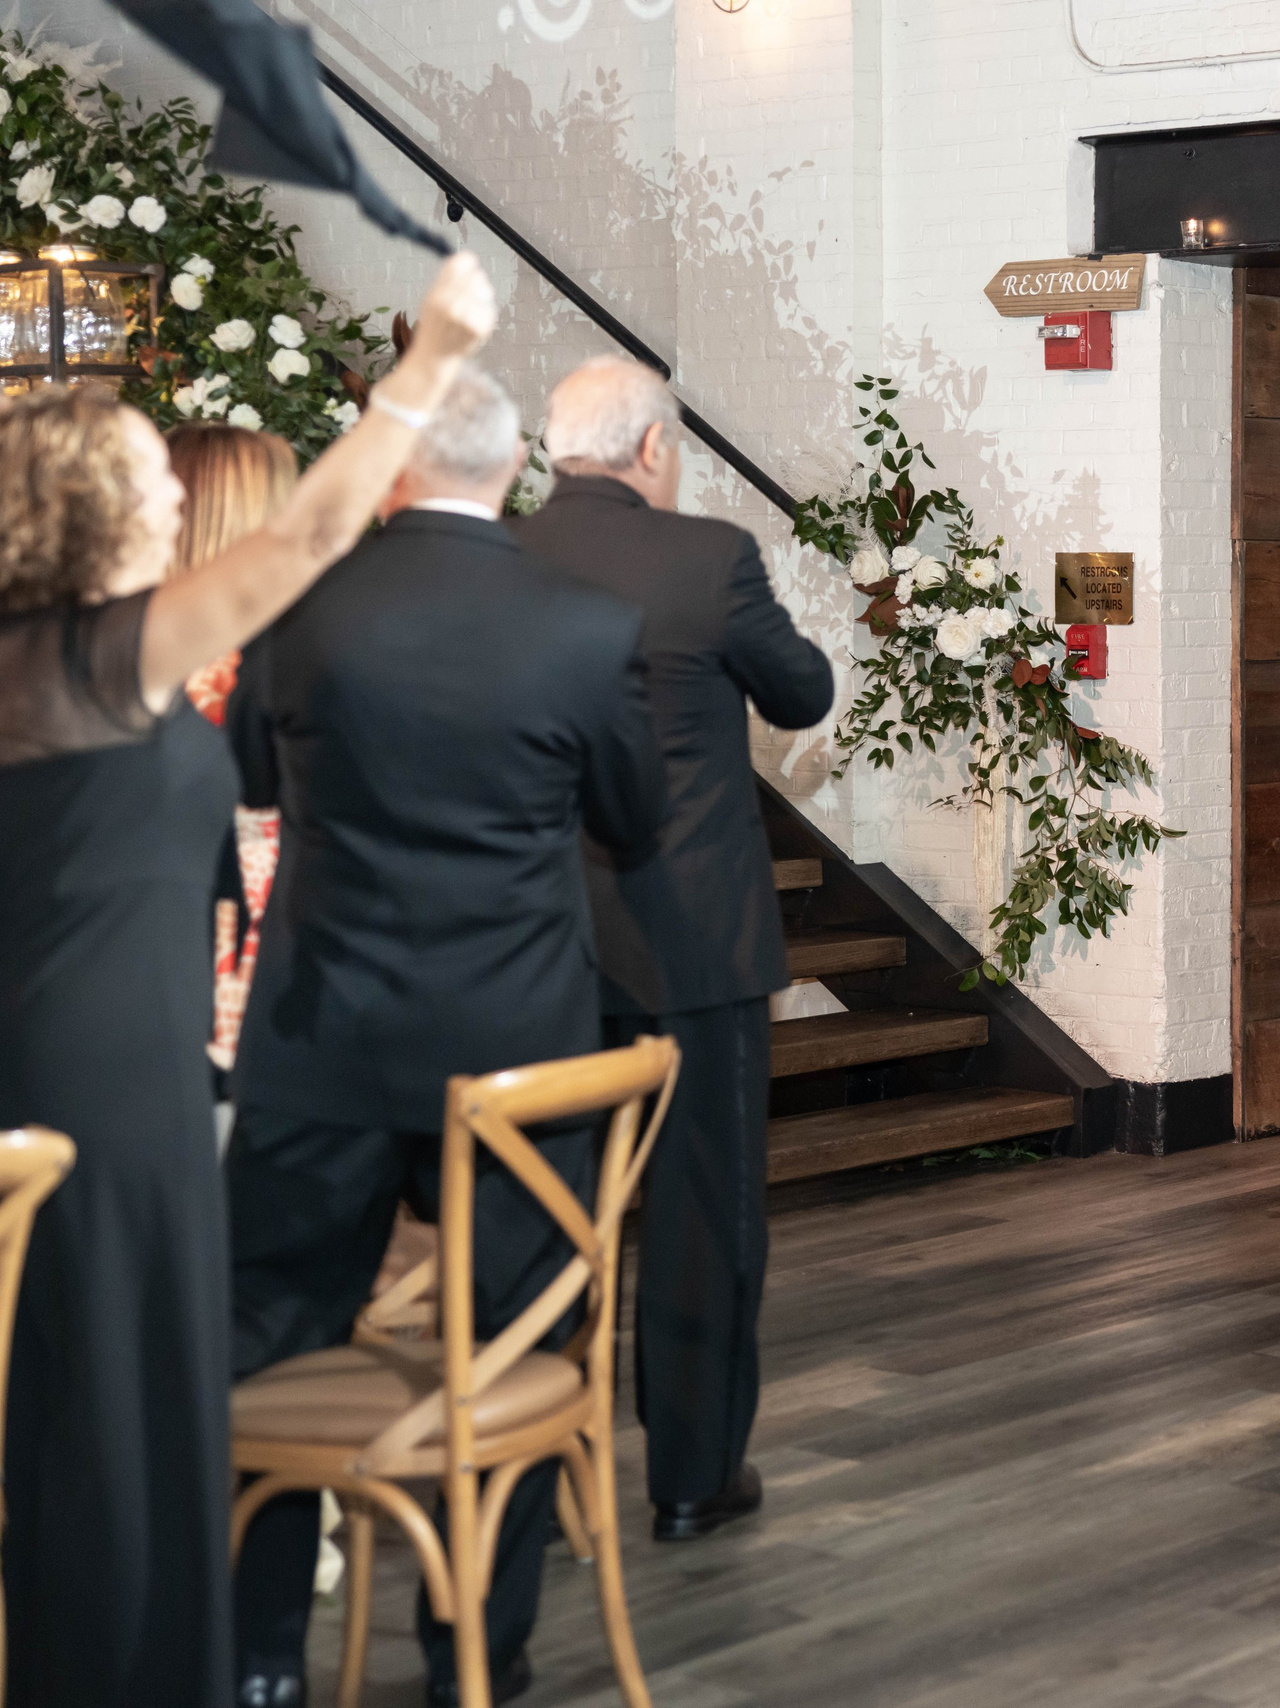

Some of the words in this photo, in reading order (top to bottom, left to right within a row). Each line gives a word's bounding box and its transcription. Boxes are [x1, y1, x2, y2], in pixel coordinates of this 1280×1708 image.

[1003, 267, 1133, 296] RESTROOM
[1081, 566, 1128, 577] RESTROOMS
[1086, 583, 1122, 593] LOCATED
[1085, 599, 1122, 610] UPSTAIRS
